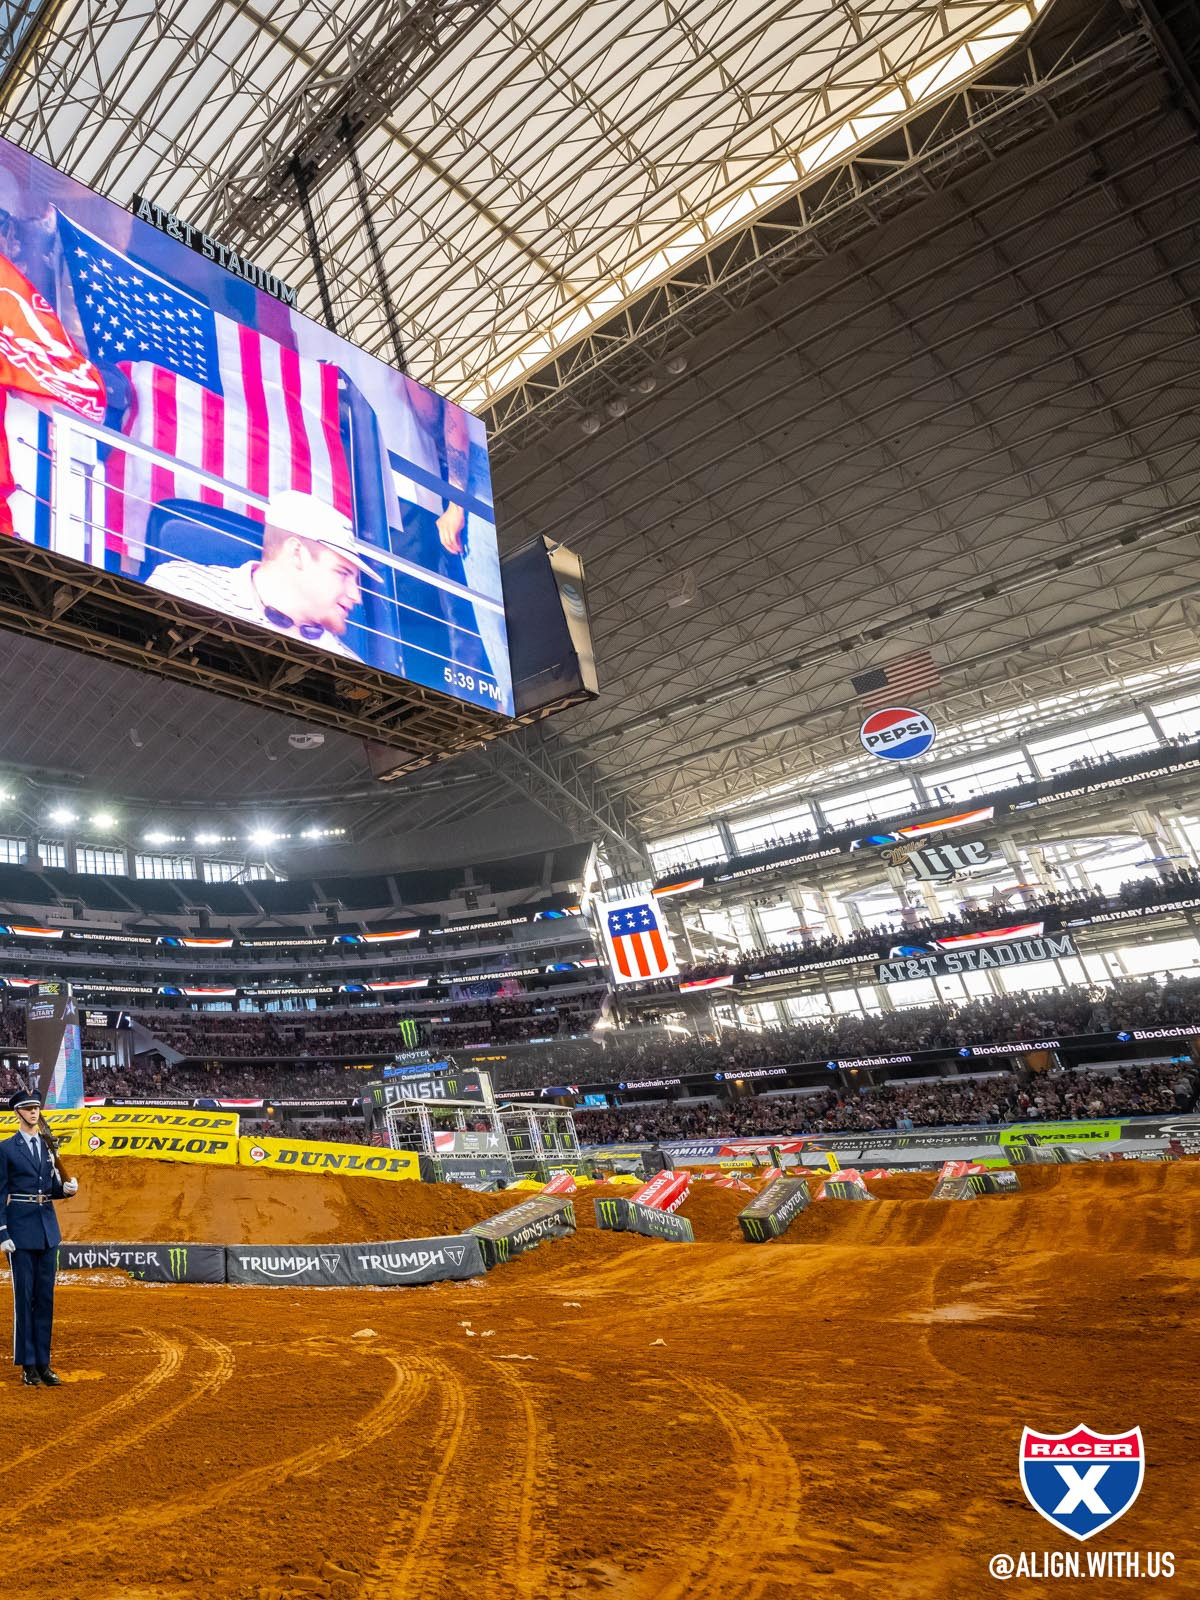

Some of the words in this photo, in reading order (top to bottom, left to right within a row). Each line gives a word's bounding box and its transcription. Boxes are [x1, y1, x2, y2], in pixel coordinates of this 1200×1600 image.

[137, 199, 197, 248] AT&T
[202, 236, 298, 307] STADIUM
[444, 667, 474, 691] 5:39
[479, 680, 501, 700] PM
[866, 721, 929, 748] PEPSI
[1037, 787, 1085, 804] MILITARY
[1087, 767, 1169, 793] APPRECIATION
[1169, 759, 1200, 773] RACE
[733, 866, 765, 878] MILITARY
[766, 853, 819, 870] APPRECIATION
[820, 847, 841, 858] RACE
[907, 842, 989, 880] Lite
[1090, 908, 1143, 923] MILITARY
[1145, 899, 1200, 915] APPRECIA
[444, 925, 470, 934] MILITARY
[470, 920, 512, 930] APPRECIATION
[764, 966, 799, 977] MILITARY
[800, 957, 857, 972] APPRECIATION
[857, 953, 880, 962] RACE
[879, 954, 937, 984] AT&T
[944, 935, 1077, 973] STADIUM
[453, 975, 480, 983] MILITARY
[480, 971, 523, 981] APPRECIATION
[395, 1050, 431, 1061] MONSTER
[972, 1039, 1060, 1056] Blockchain.com
[384, 1062, 449, 1078] SUPERCROSS
[838, 1054, 911, 1069] Blockchain.com
[627, 1078, 681, 1089] Blockchain.com
[724, 1068, 787, 1080] Blockchain.com
[384, 1080, 446, 1103] FINISH
[109, 1113, 233, 1129] DUNLOP
[109, 1136, 229, 1154] DUNLOP
[915, 1136, 977, 1144] MONSTER
[1010, 1131, 1110, 1142] Kwasaki
[274, 1149, 411, 1173] DUNLOP
[776, 1191, 804, 1221] MONSTER
[513, 1214, 561, 1246] MONSTER
[639, 1207, 684, 1230] MONSTER
[68, 1250, 160, 1269] MONSTER
[239, 1255, 319, 1278] TRIUMPH
[358, 1251, 444, 1275] TRIUMPH
